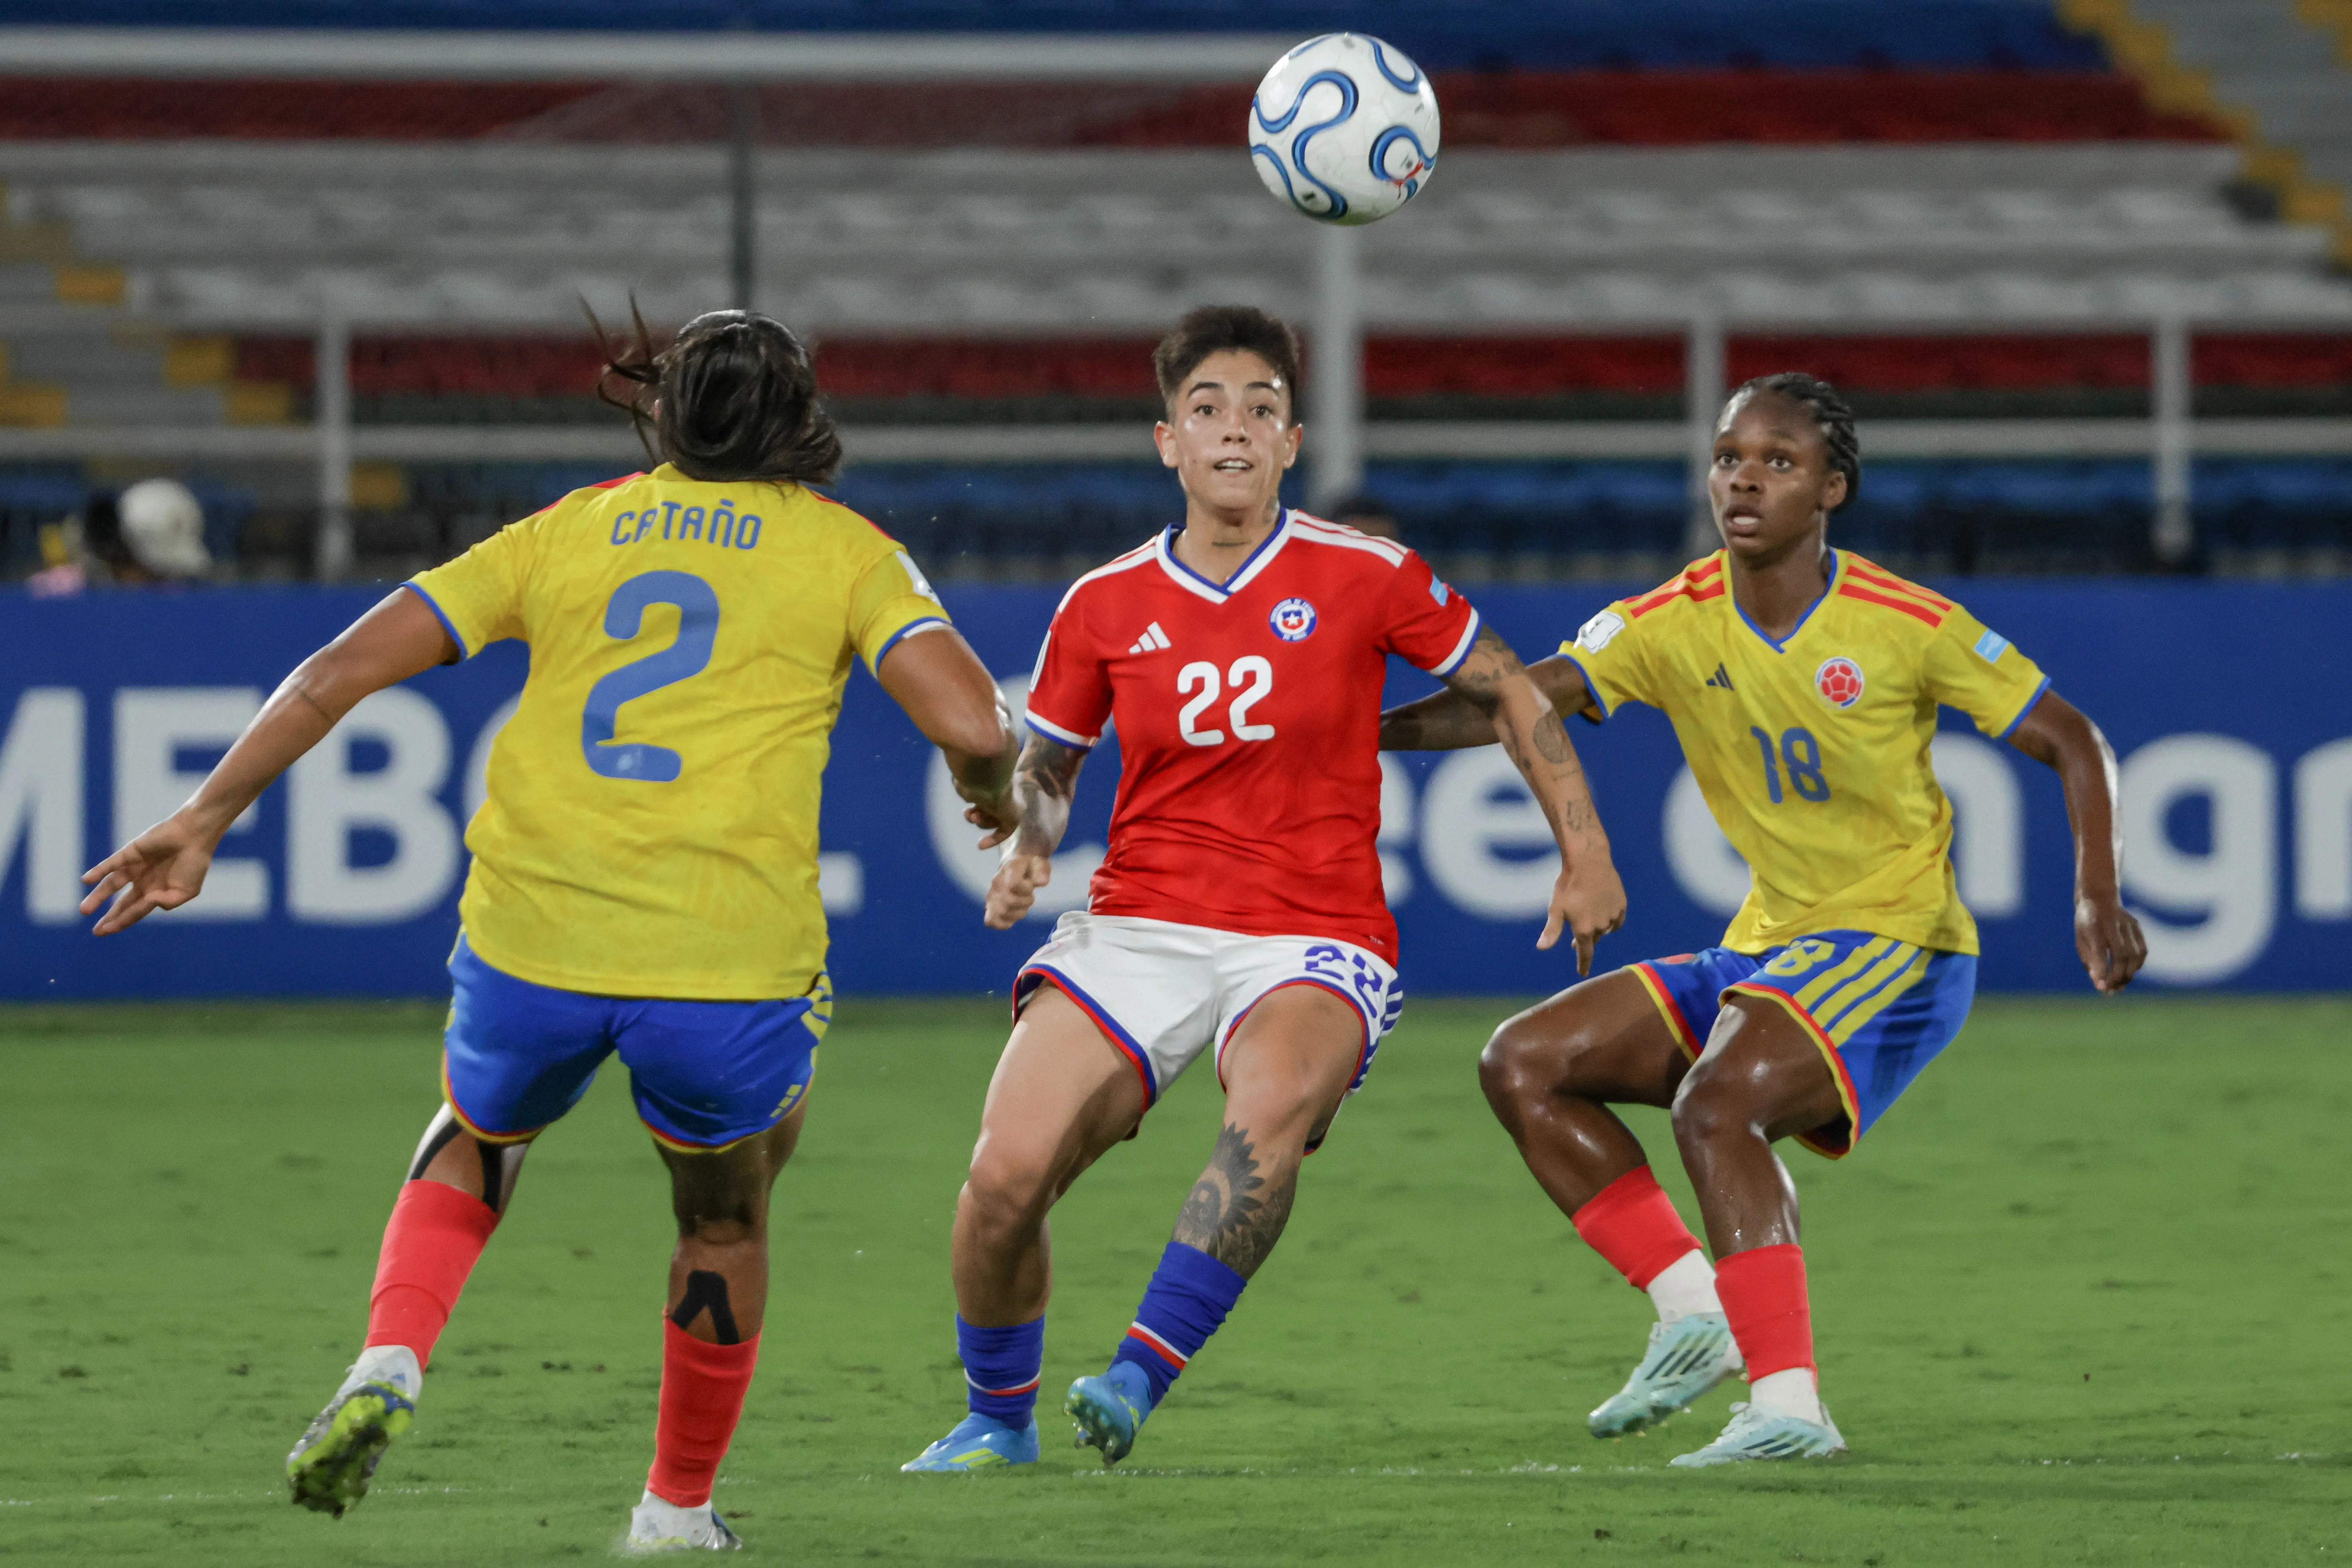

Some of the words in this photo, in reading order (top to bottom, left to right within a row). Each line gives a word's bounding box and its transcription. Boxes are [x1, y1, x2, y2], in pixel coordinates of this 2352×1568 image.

[610, 499, 762, 549] CATAÑO
[581, 569, 719, 782] 2
[1177, 655, 1275, 746] 22
[1750, 725, 1831, 804] 18
